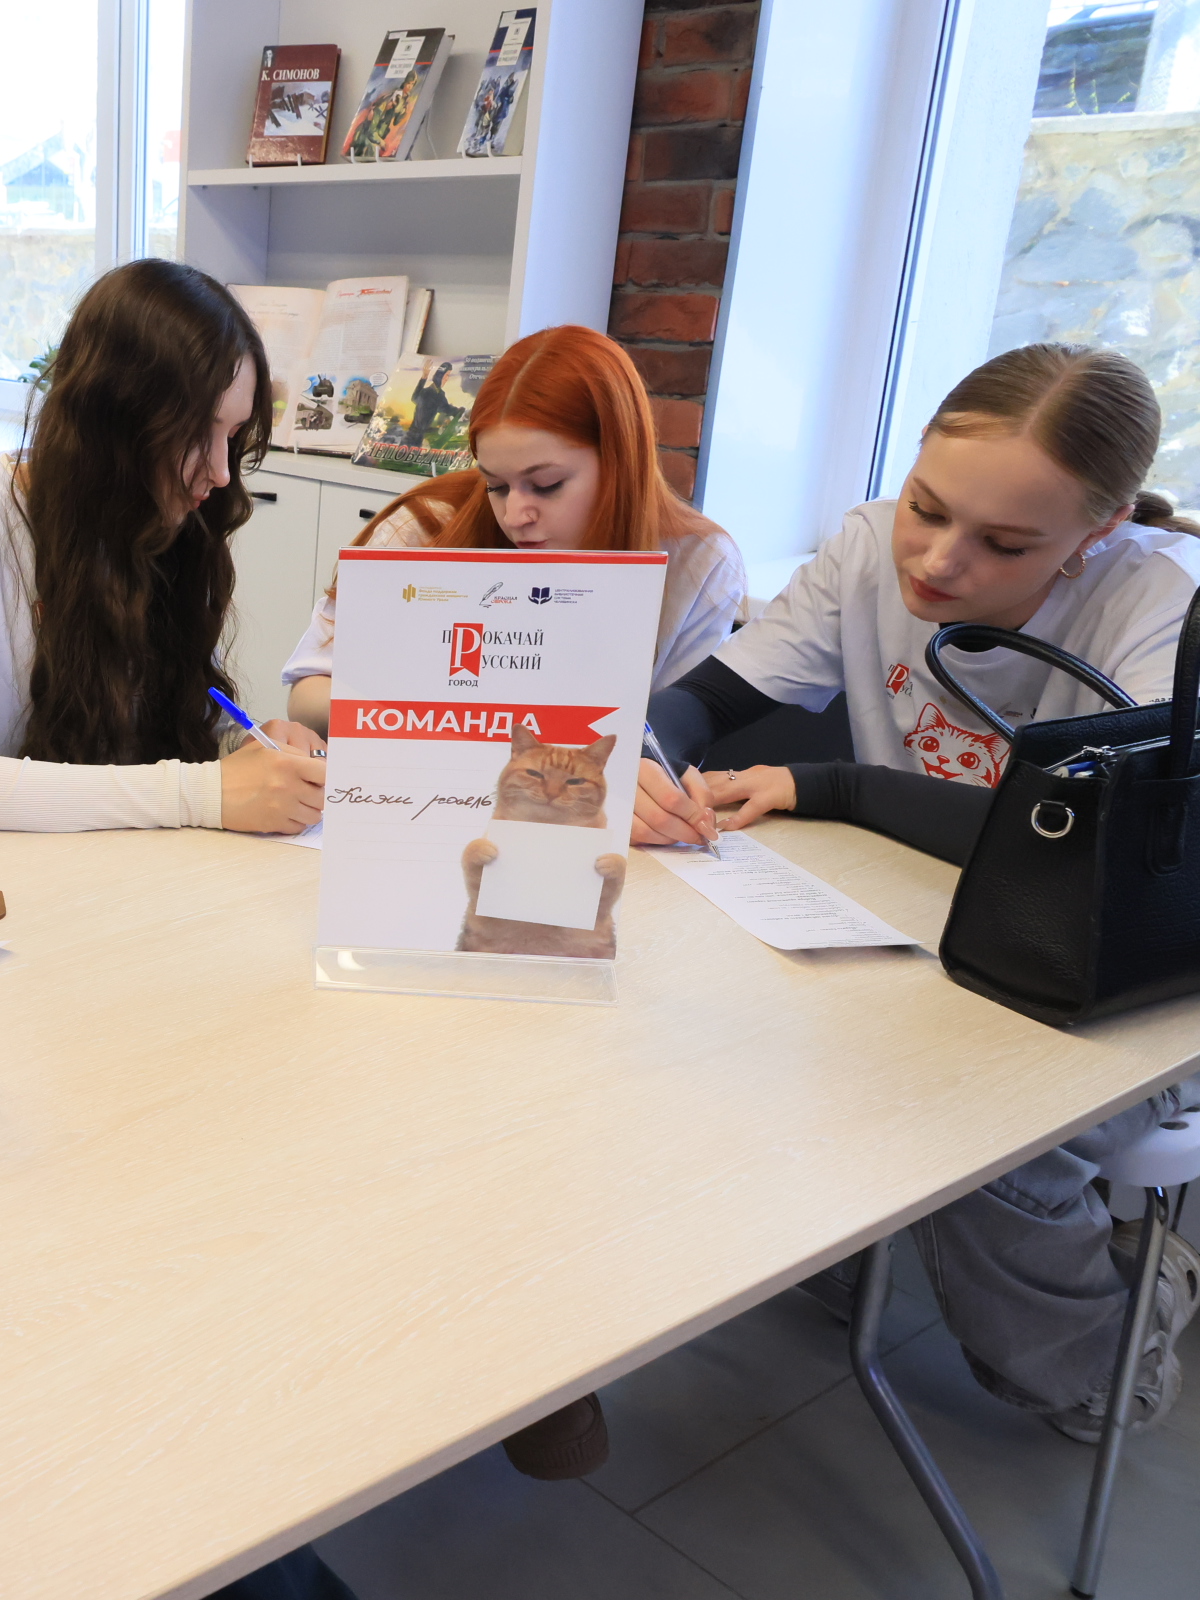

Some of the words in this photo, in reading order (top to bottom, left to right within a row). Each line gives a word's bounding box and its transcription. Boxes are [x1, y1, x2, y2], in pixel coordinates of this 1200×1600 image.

[273, 68, 320, 80] СИМОНОВ
[448, 679, 479, 688] ГОРОД
[356, 707, 542, 738] КОМАНДА
